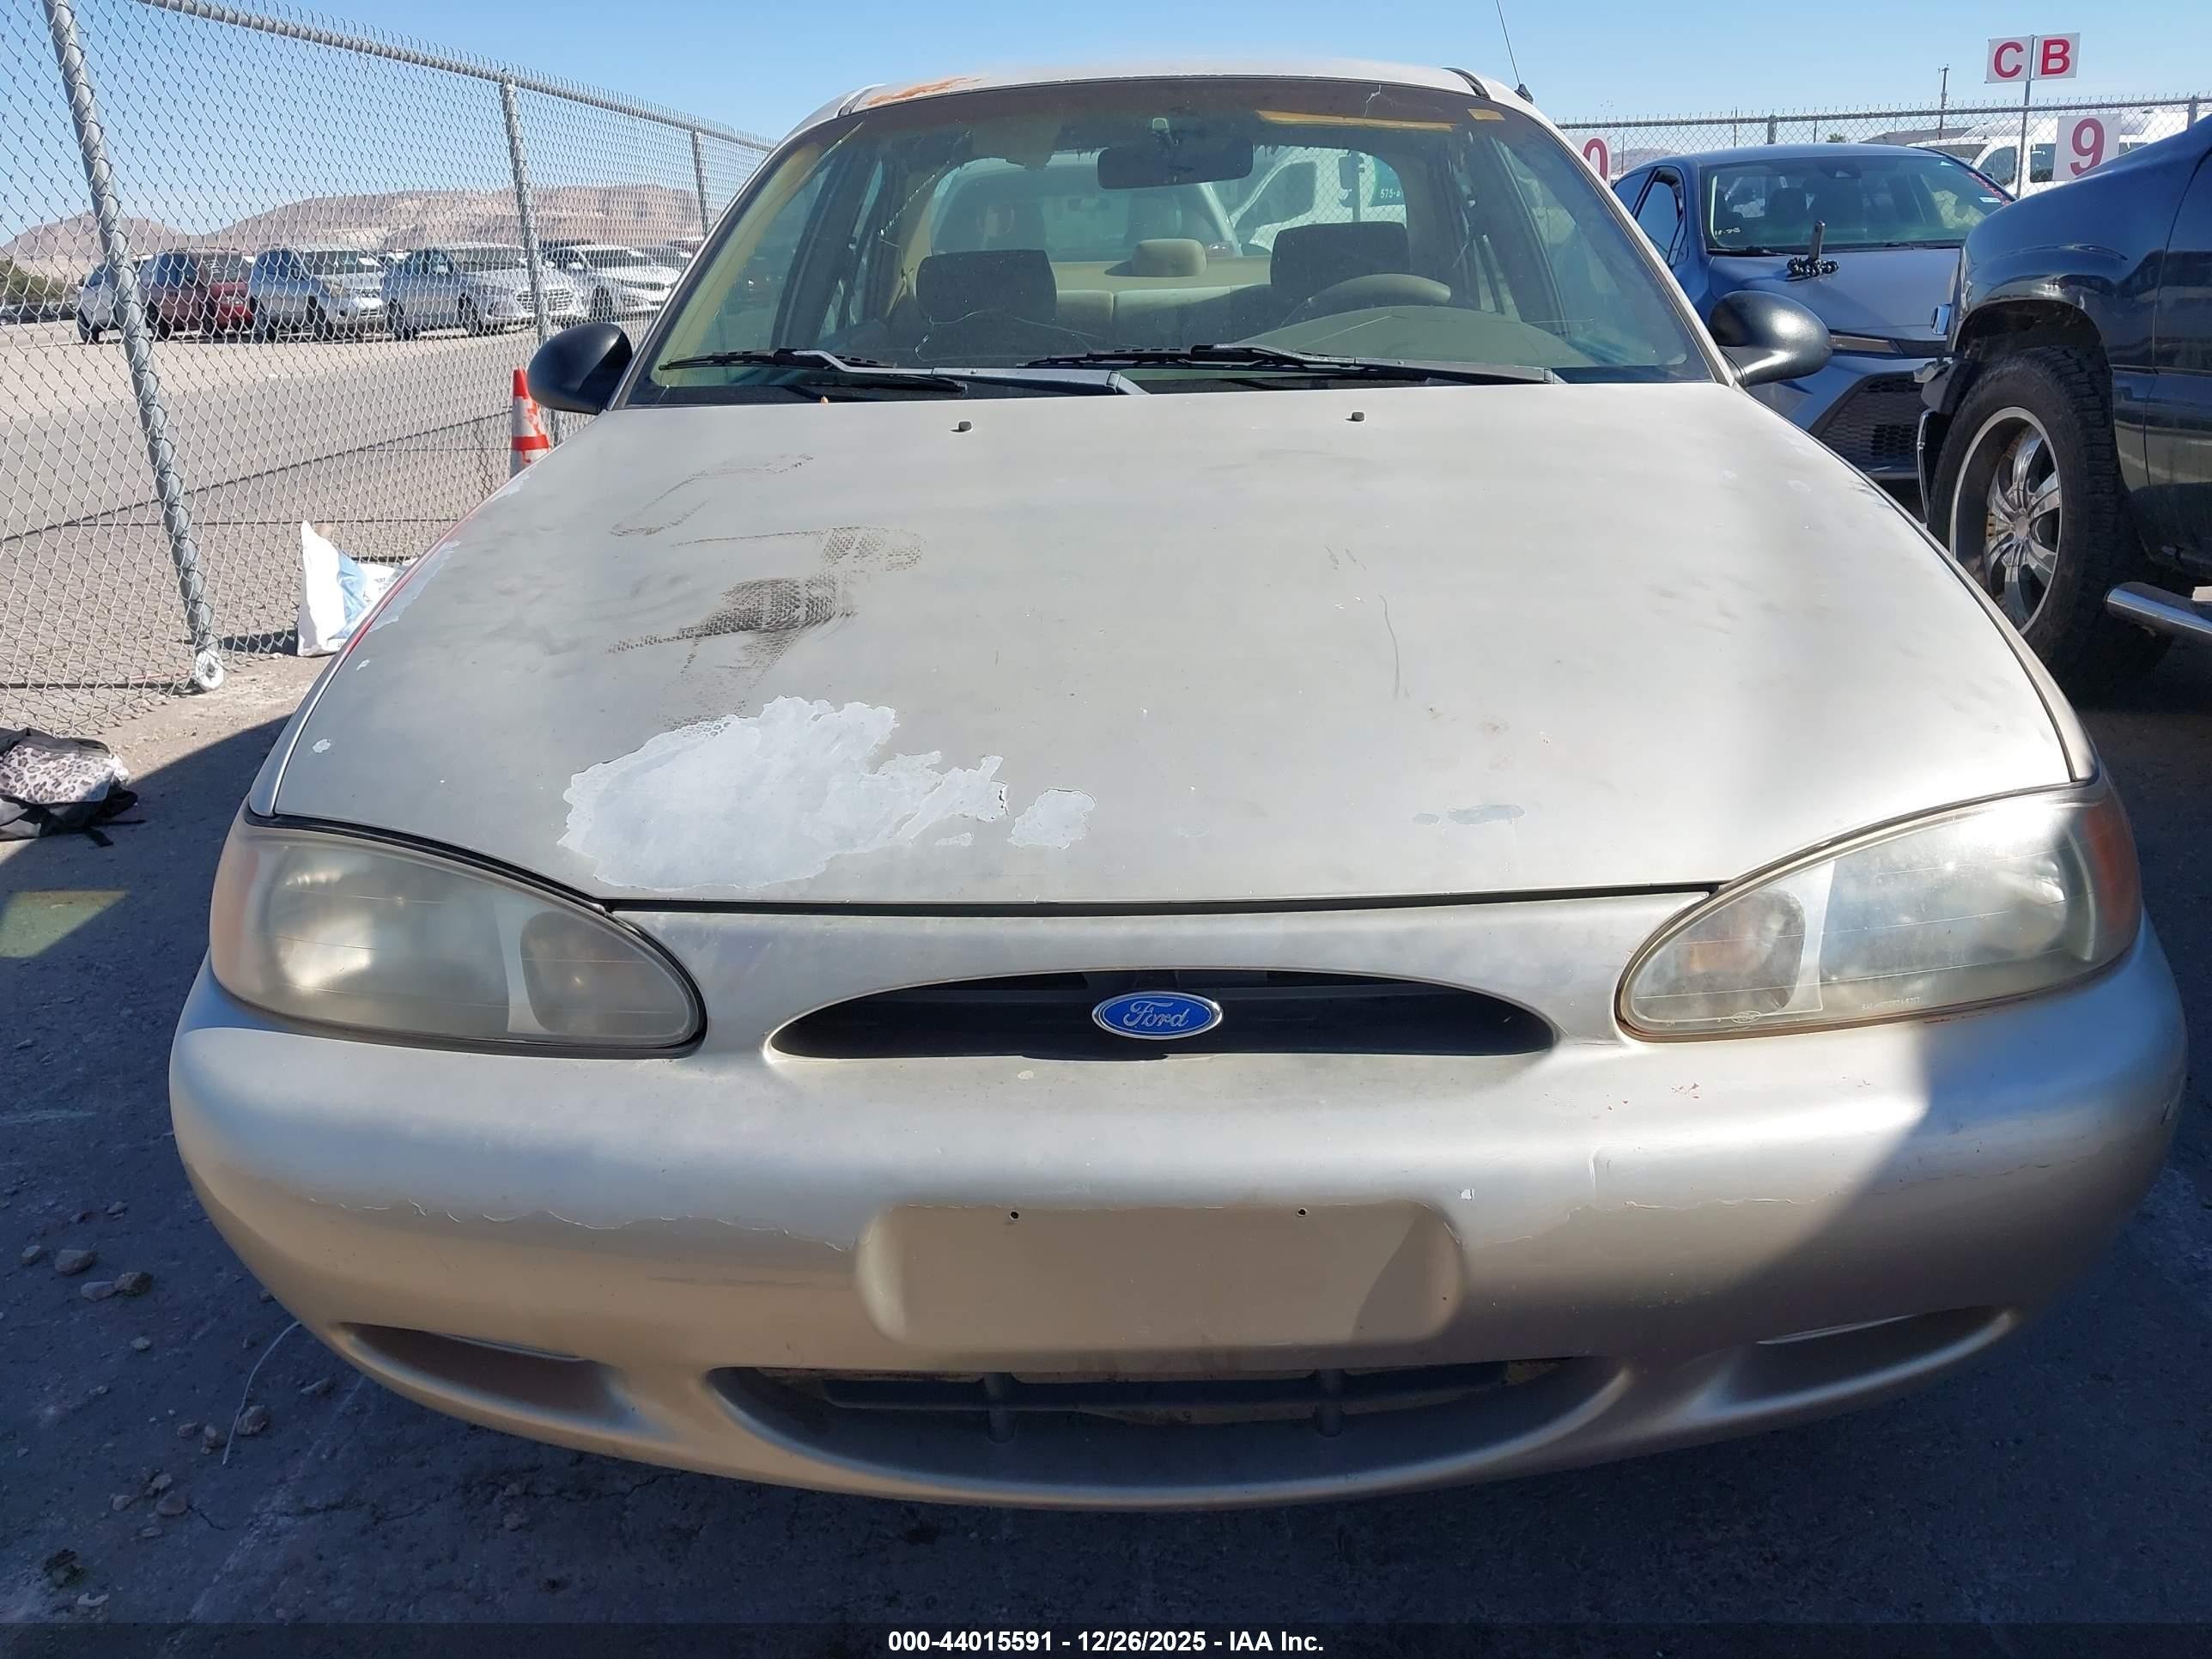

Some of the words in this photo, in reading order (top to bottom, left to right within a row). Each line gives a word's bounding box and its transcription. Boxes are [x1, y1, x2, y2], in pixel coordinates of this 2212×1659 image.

[1994, 41, 2024, 78] C
[2041, 39, 2070, 76] B
[2069, 118, 2105, 176] 9
[1122, 1000, 1191, 1028] Ford
